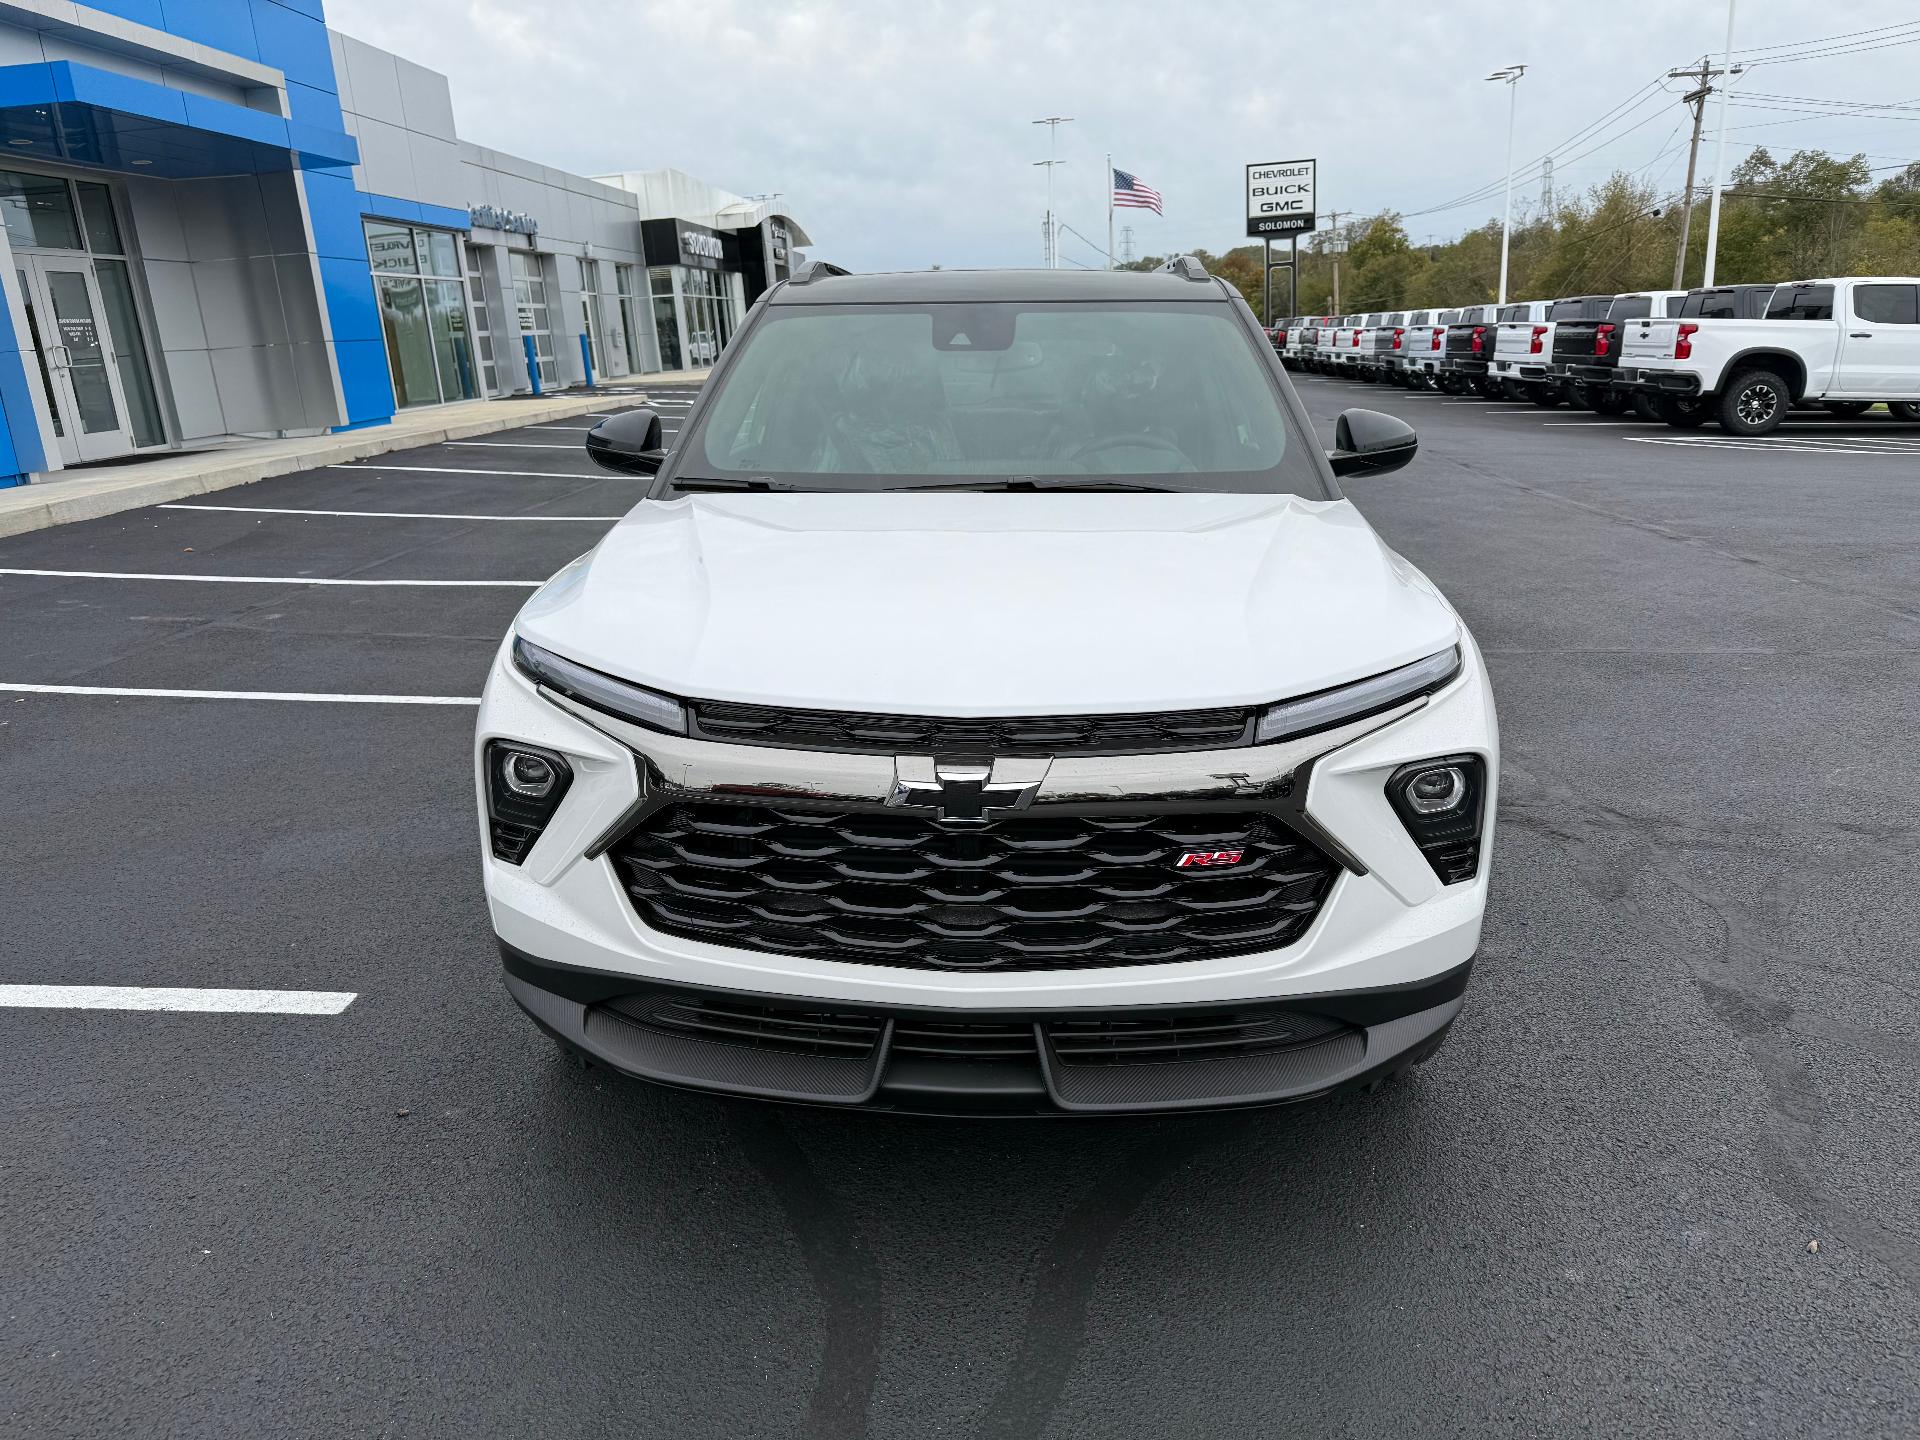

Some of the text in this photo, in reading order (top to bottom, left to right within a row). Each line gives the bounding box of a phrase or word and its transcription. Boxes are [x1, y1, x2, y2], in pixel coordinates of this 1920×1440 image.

[1252, 167, 1310, 179] CHEVROLET
[1252, 183, 1311, 196] BUICK
[1260, 200, 1304, 213] GMC
[1258, 219, 1304, 230] SOLOMON
[1176, 850, 1244, 867] RS
